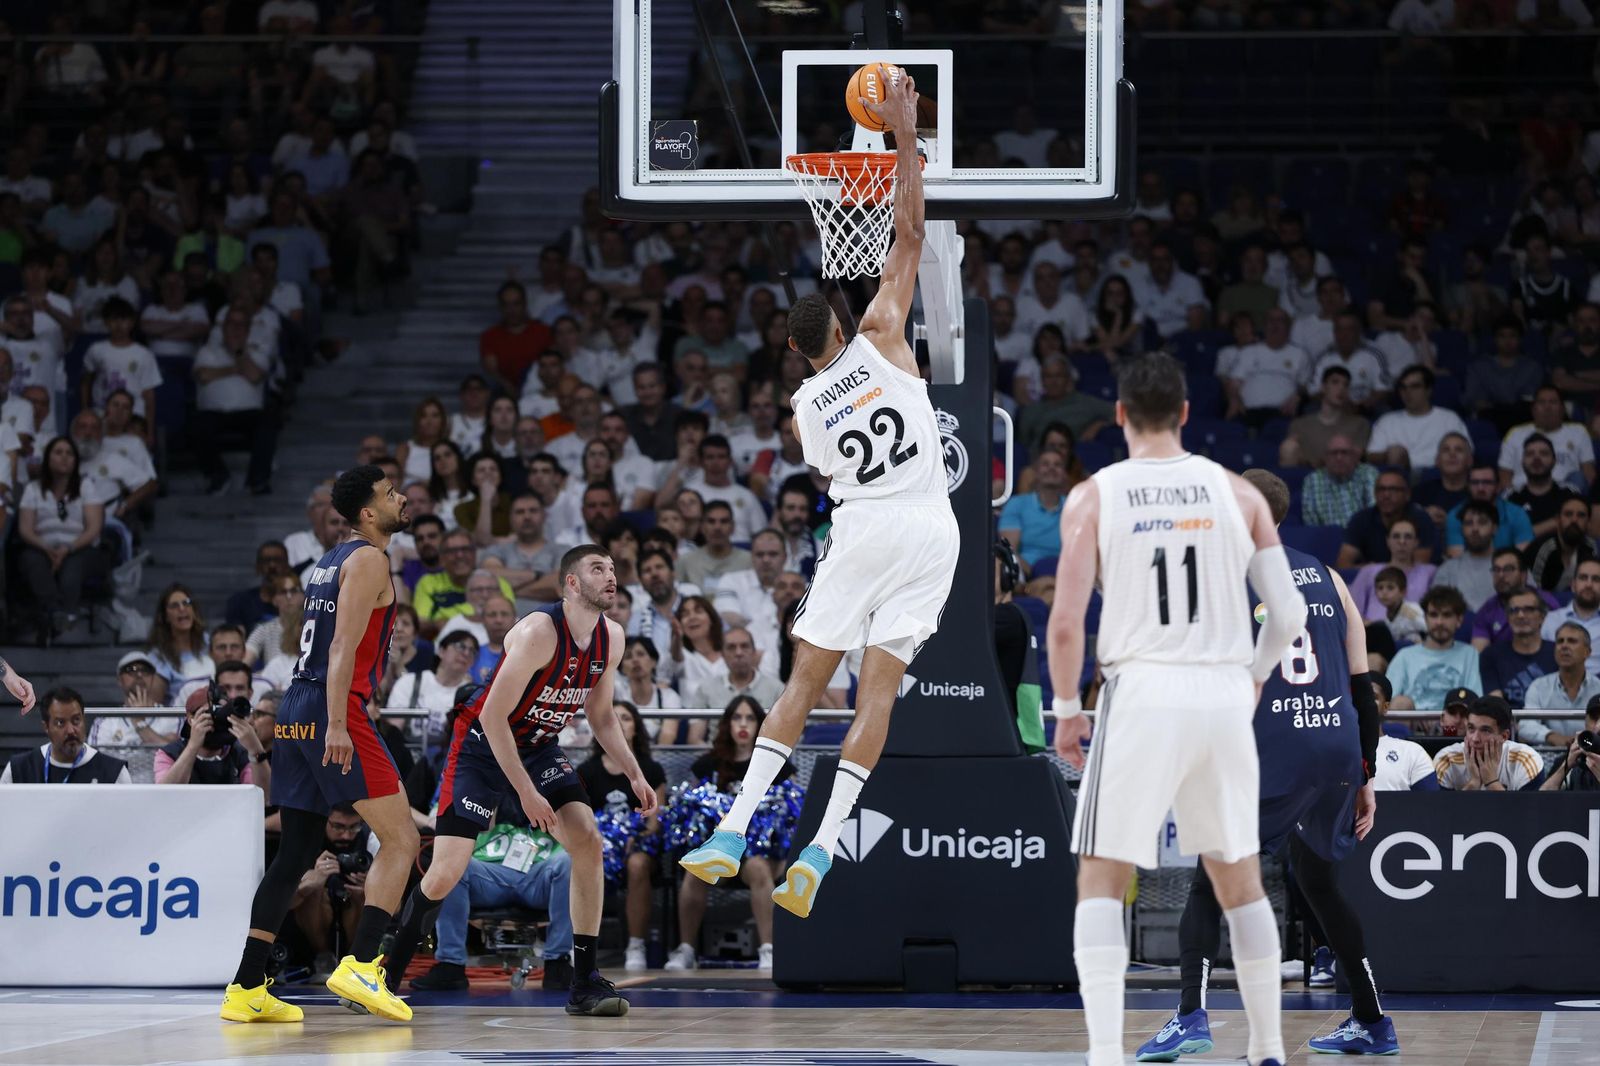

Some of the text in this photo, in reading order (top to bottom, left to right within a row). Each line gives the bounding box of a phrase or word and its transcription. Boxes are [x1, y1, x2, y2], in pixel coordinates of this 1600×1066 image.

[811, 365, 871, 412] TAVARES
[825, 387, 883, 430] AUTOHERO
[838, 407, 918, 485] 22
[1127, 485, 1211, 508] HEZONJA
[1132, 518, 1215, 534] AUTOHERO
[1150, 545, 1199, 625] 11
[1291, 567, 1322, 587] SKIS
[298, 619, 316, 671] 9
[1280, 626, 1319, 684] 8
[920, 682, 985, 700] Unicaja
[1271, 692, 1325, 713] araba
[1293, 710, 1341, 728] álava
[902, 828, 1045, 868] Unicaja
[1370, 809, 1600, 900] end
[2, 861, 199, 935] nicaja
